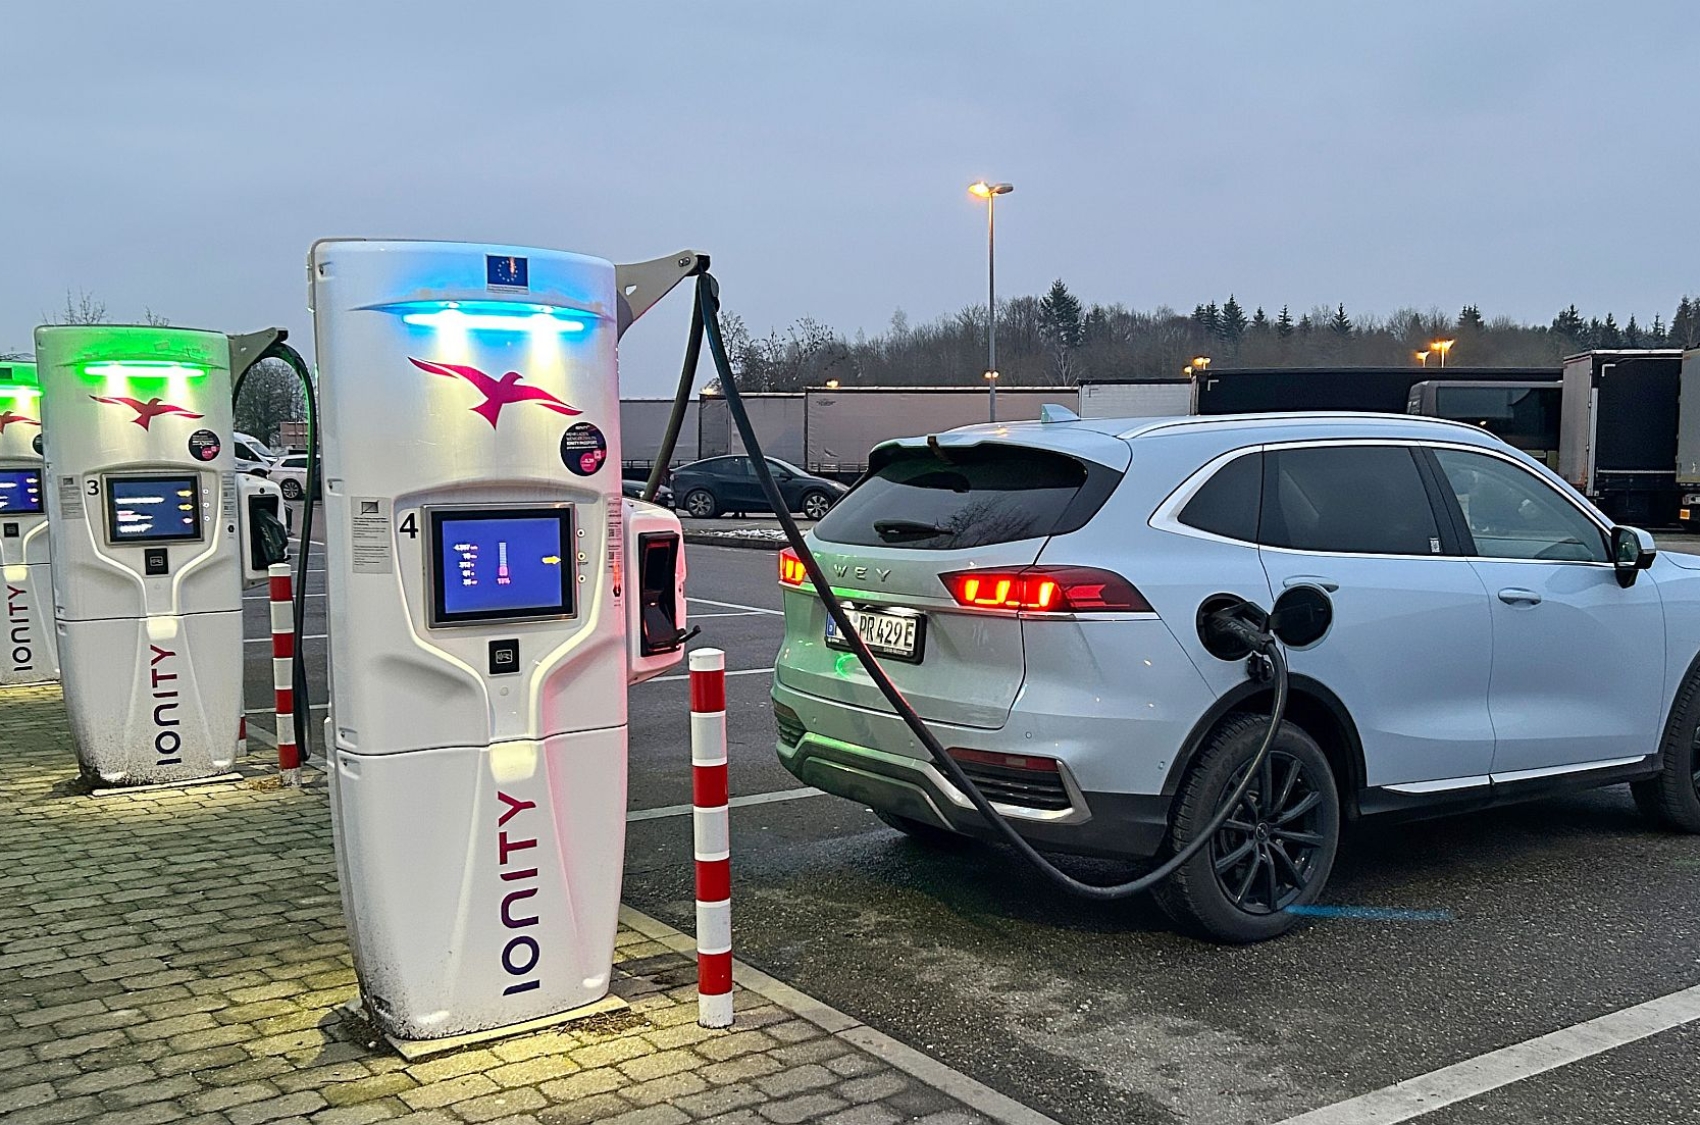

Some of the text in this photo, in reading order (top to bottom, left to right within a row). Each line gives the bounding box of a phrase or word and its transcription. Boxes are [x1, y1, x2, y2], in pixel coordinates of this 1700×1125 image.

[86, 480, 99, 496] 3
[399, 512, 419, 539] 4
[833, 564, 891, 582] WEY
[7, 584, 33, 671] IONITY
[150, 644, 182, 766] IONITY
[497, 791, 541, 997] IONITY
